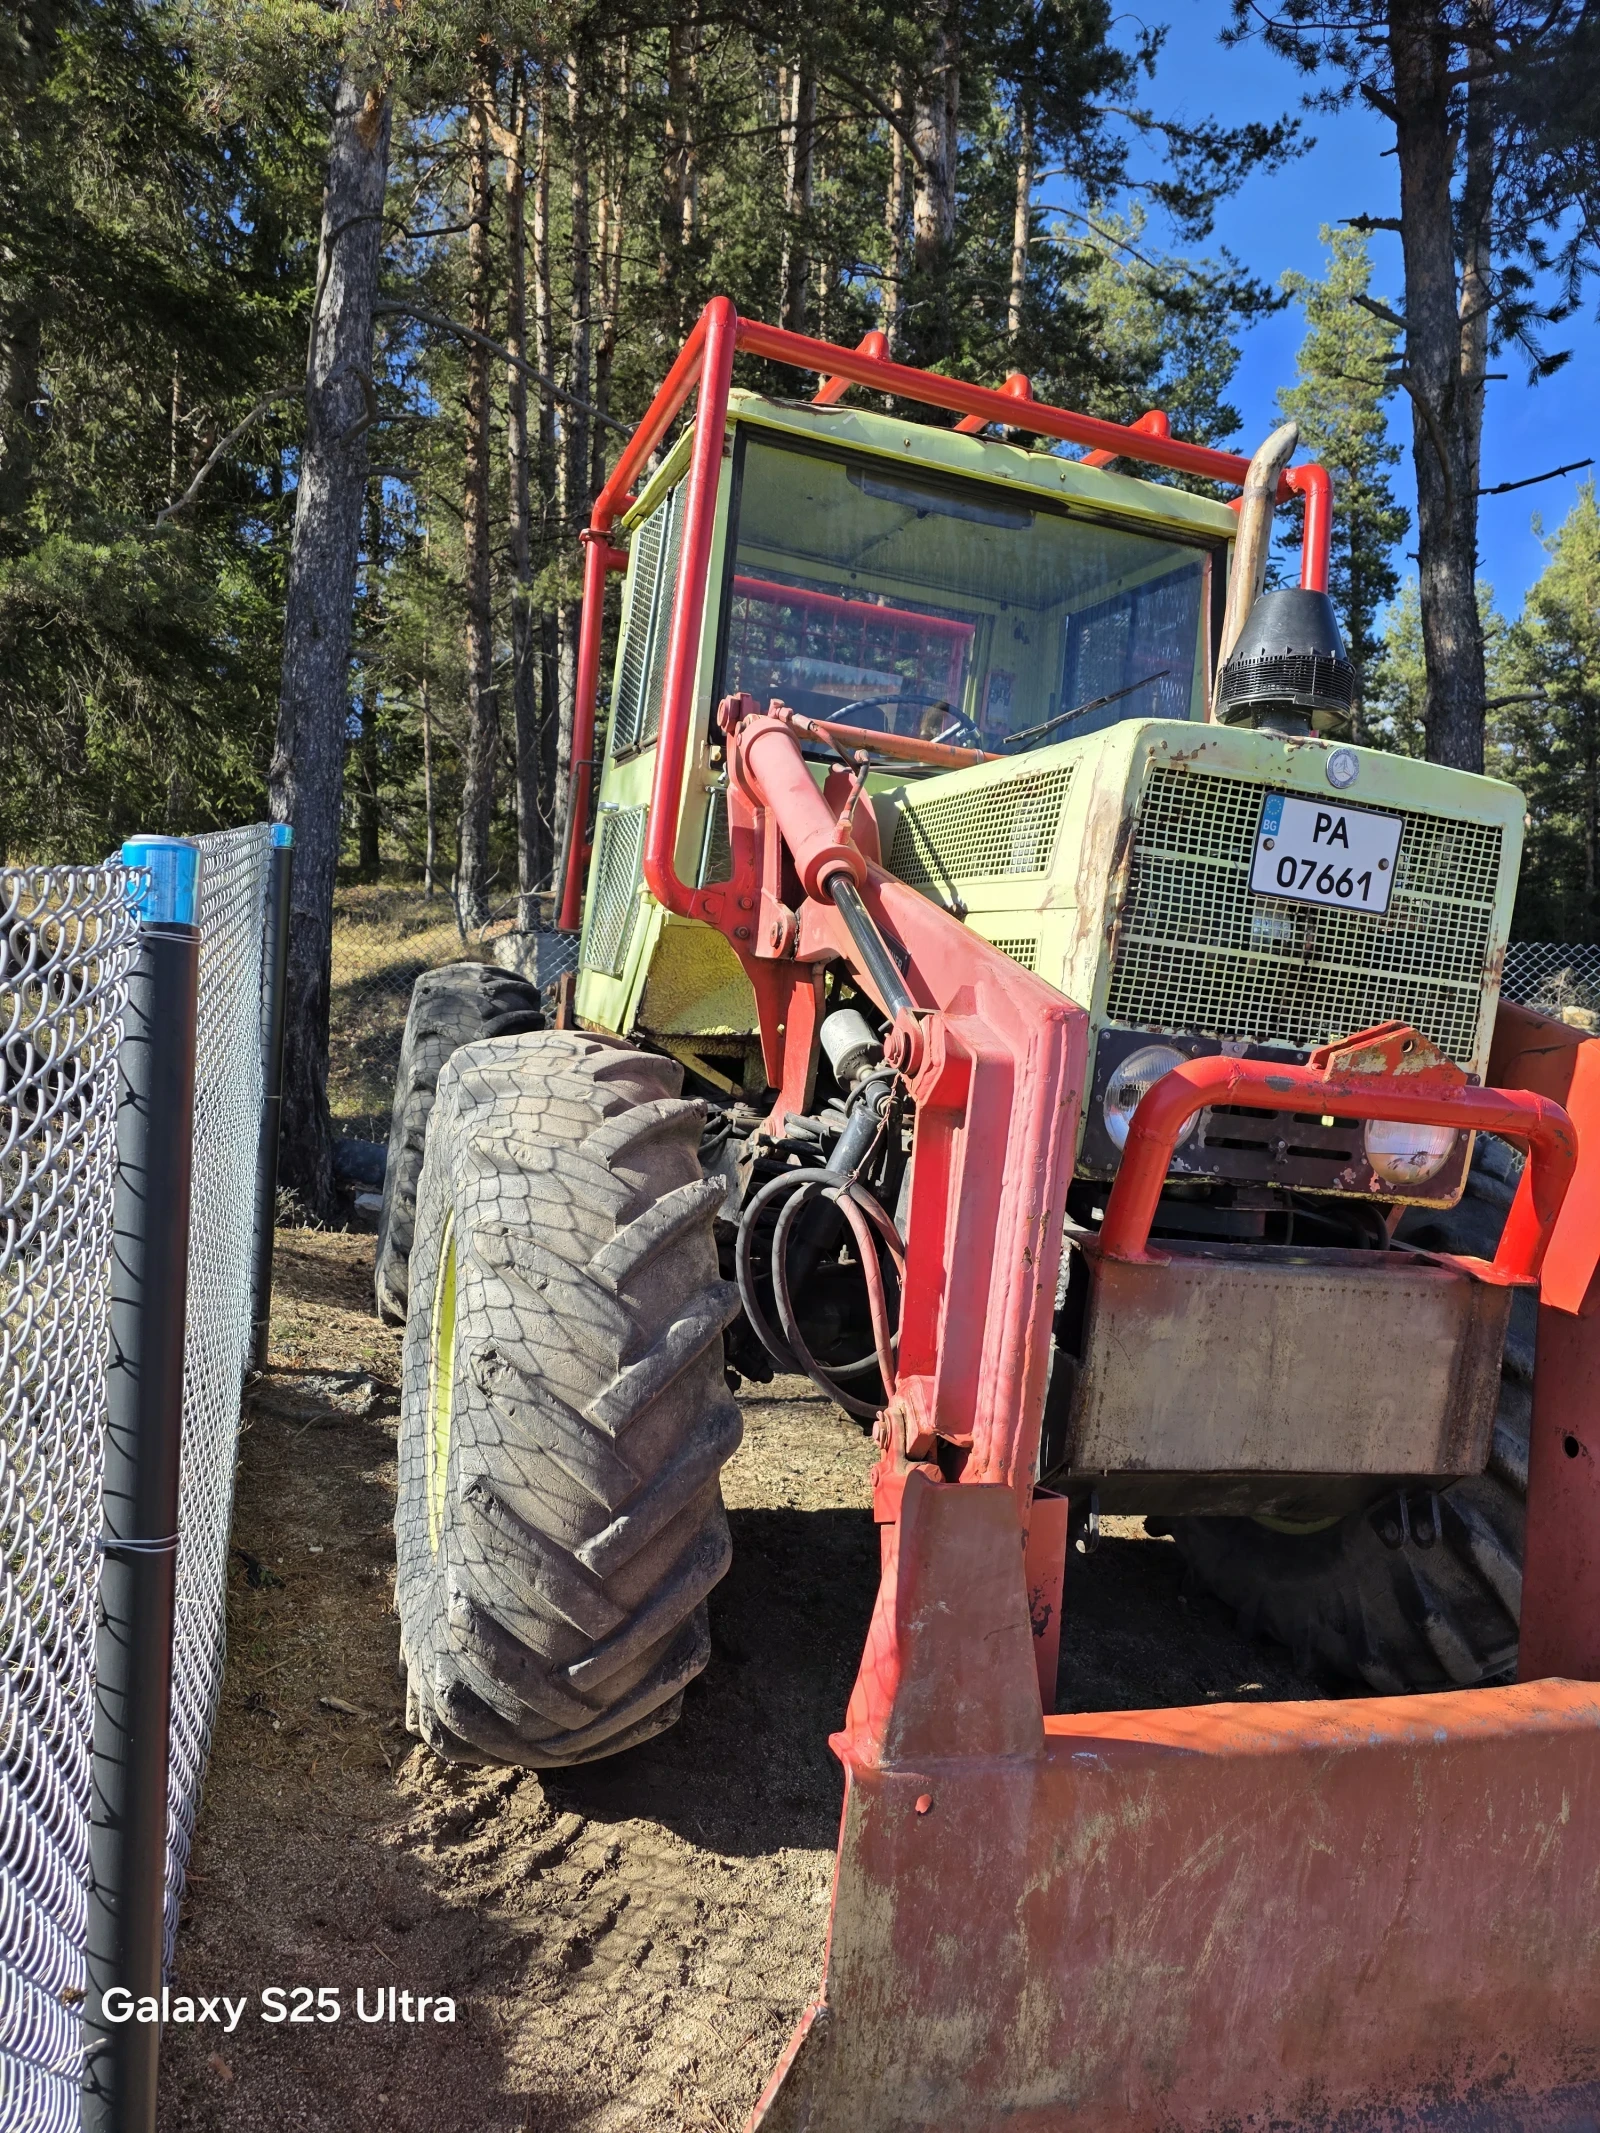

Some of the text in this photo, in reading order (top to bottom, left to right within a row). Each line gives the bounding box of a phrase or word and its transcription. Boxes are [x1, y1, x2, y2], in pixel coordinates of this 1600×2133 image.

[1263, 818, 1277, 832] BG
[1312, 812, 1349, 849] PA
[1276, 856, 1372, 901] 07661
